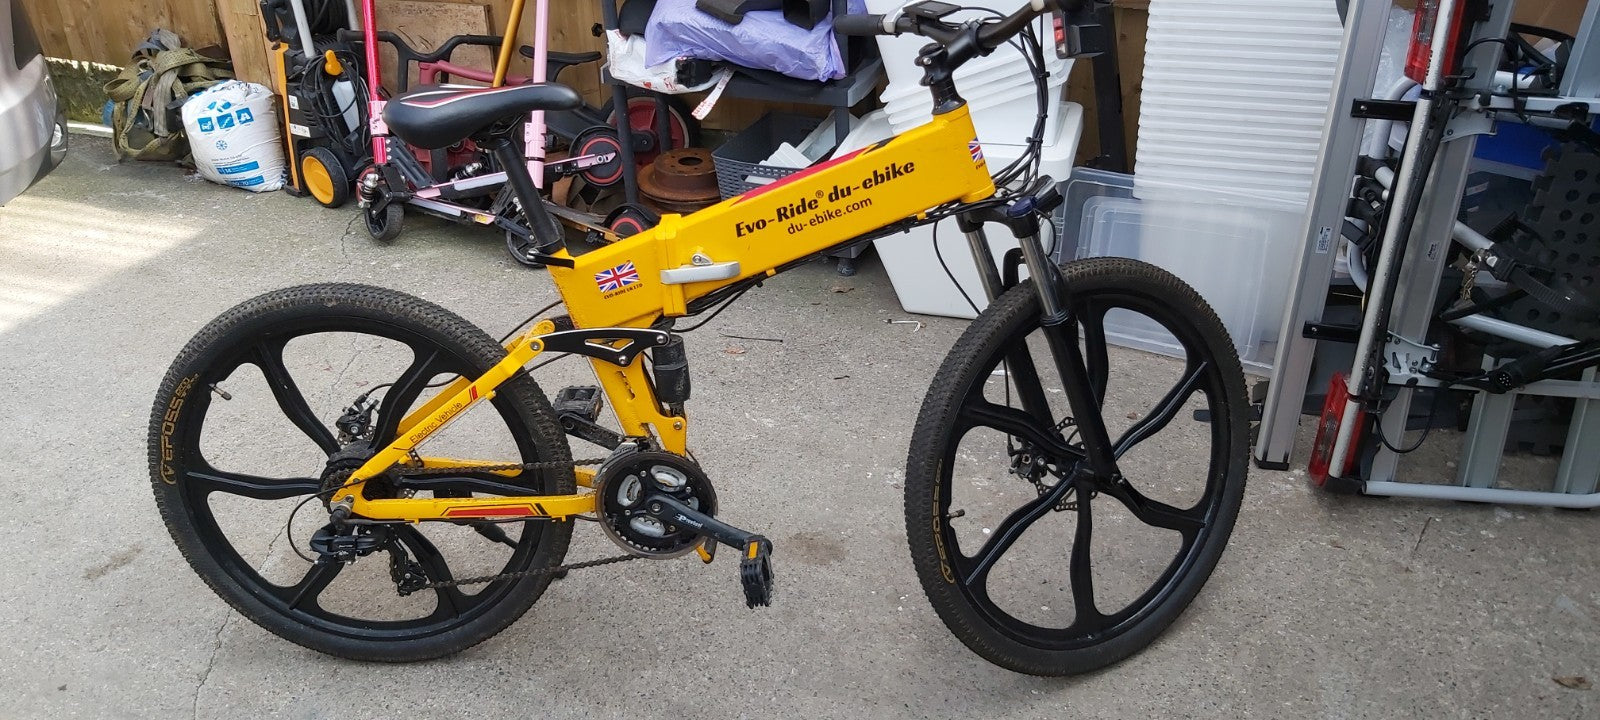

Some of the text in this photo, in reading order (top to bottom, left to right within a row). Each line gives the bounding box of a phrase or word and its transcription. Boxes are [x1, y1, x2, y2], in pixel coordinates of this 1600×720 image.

[828, 161, 915, 203] du-ebike
[787, 197, 873, 235] du-ebike.com
[409, 402, 463, 444] Electric Vehicle
